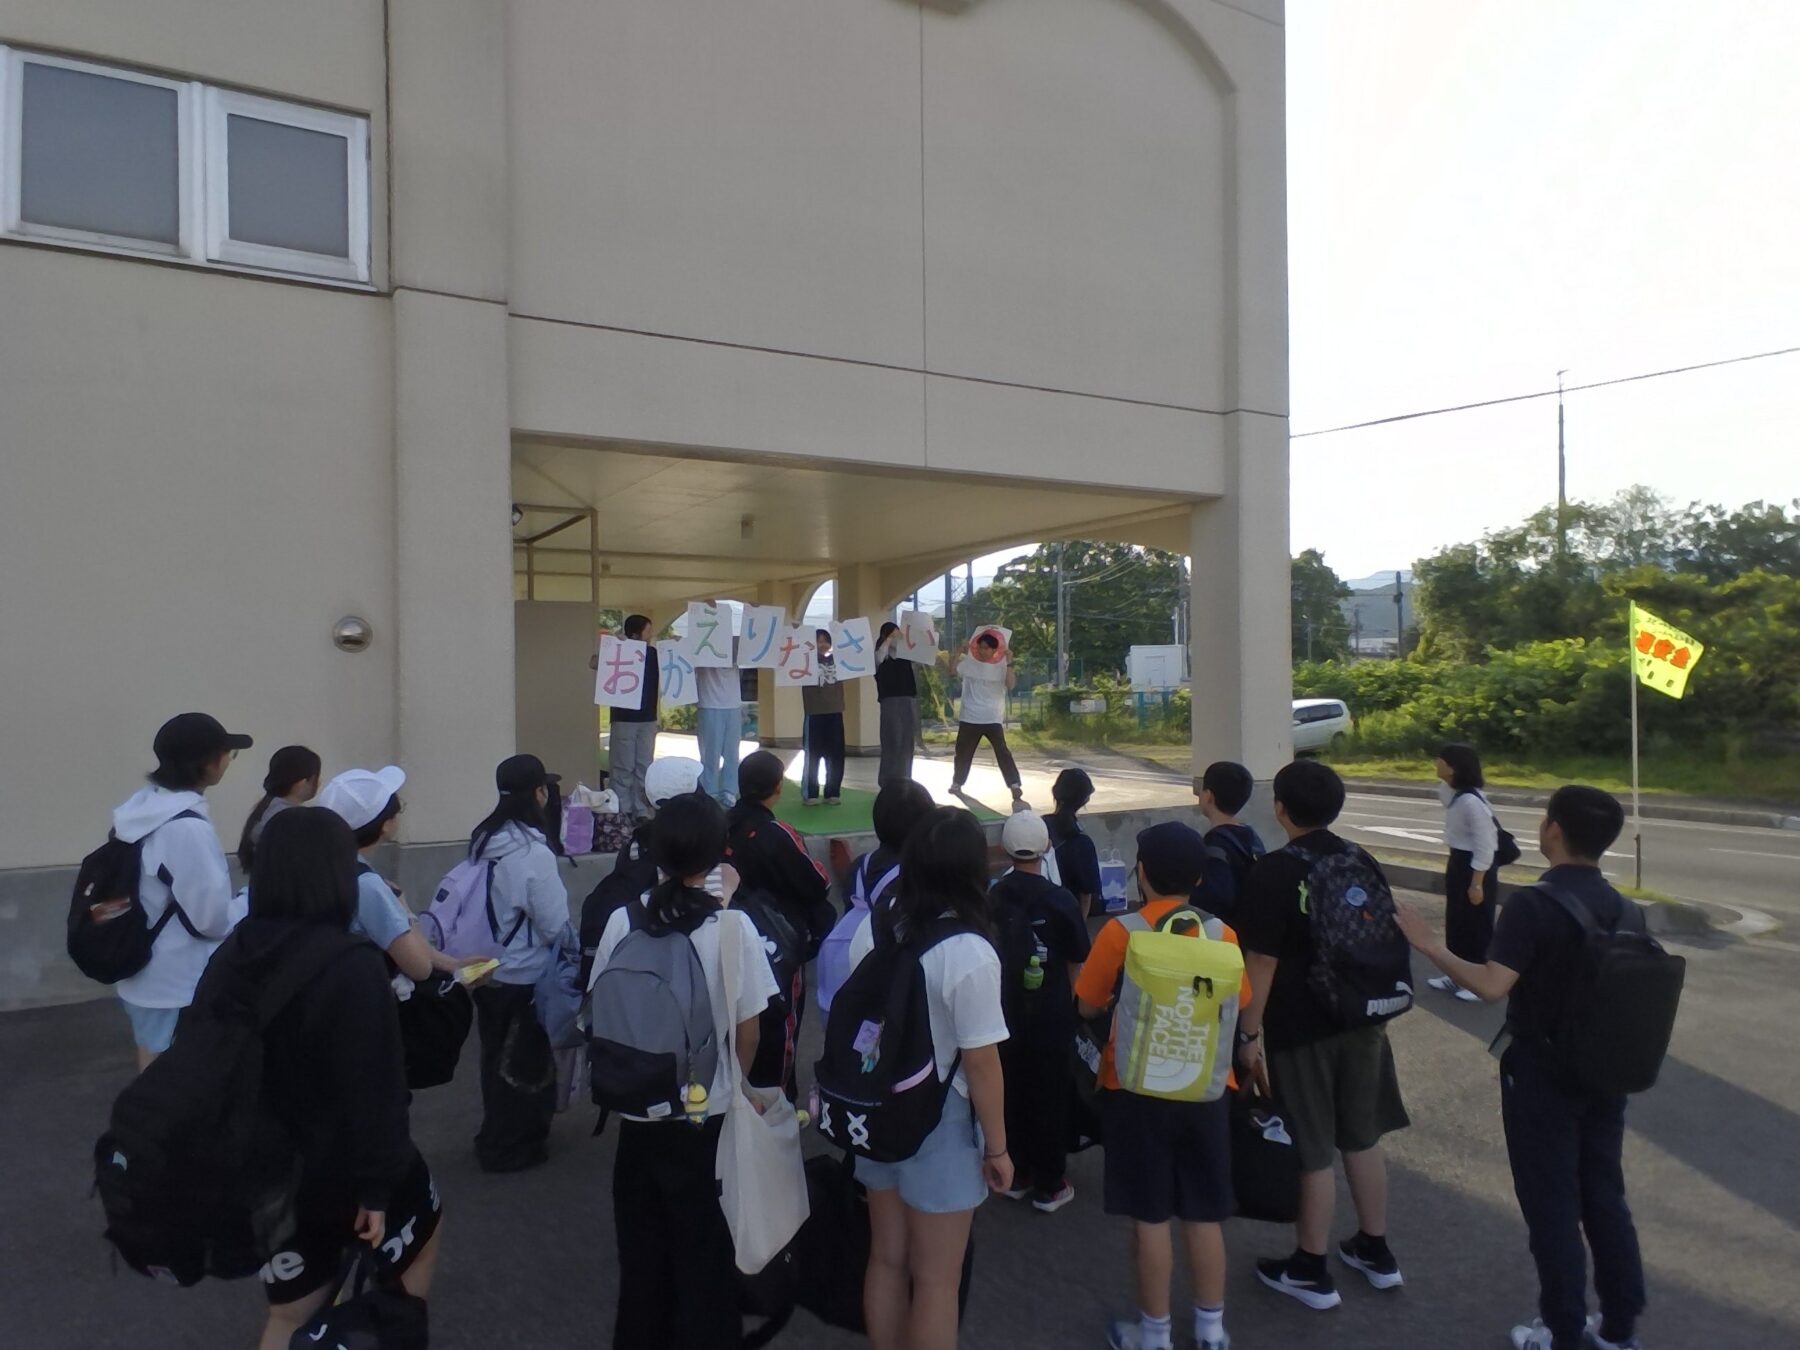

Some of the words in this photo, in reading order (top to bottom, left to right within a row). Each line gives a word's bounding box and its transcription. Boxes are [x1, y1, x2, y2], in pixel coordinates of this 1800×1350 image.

[1148, 1004, 1174, 1057] FACE
[1166, 986, 1195, 1060] NORTH
[1188, 1023, 1211, 1064] THE
